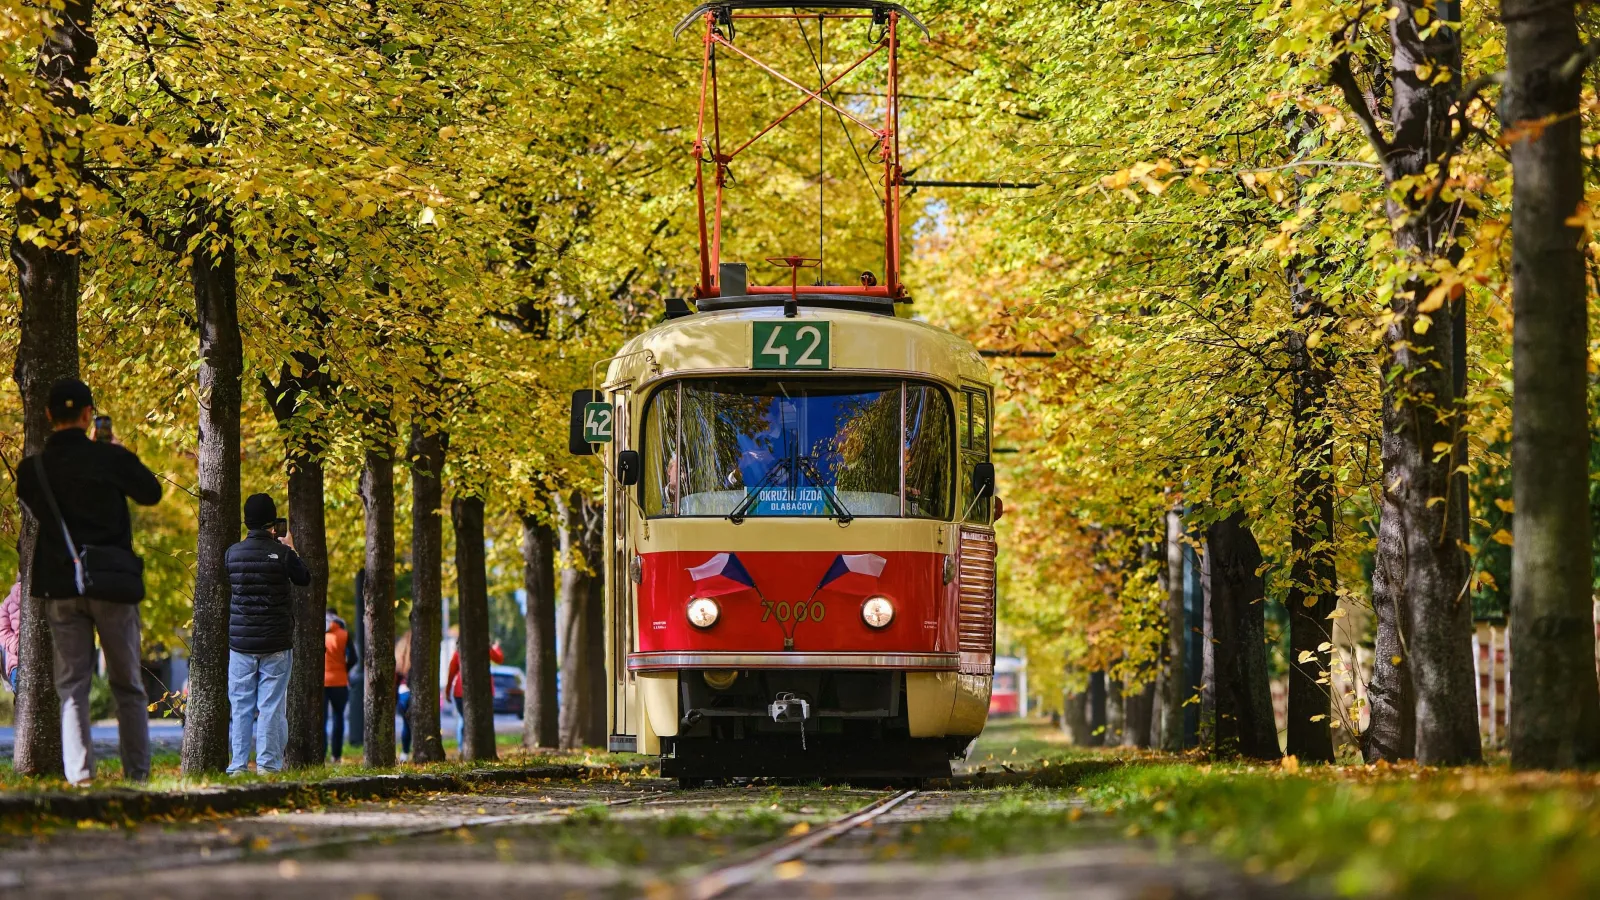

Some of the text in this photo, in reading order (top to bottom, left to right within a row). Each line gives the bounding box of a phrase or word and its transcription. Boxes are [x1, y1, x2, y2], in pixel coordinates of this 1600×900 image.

[761, 325, 822, 366] 42
[585, 409, 612, 436] 42
[771, 501, 812, 511] DLABAČOV
[800, 489, 823, 501] JÍZDA
[760, 600, 825, 623] 7000
